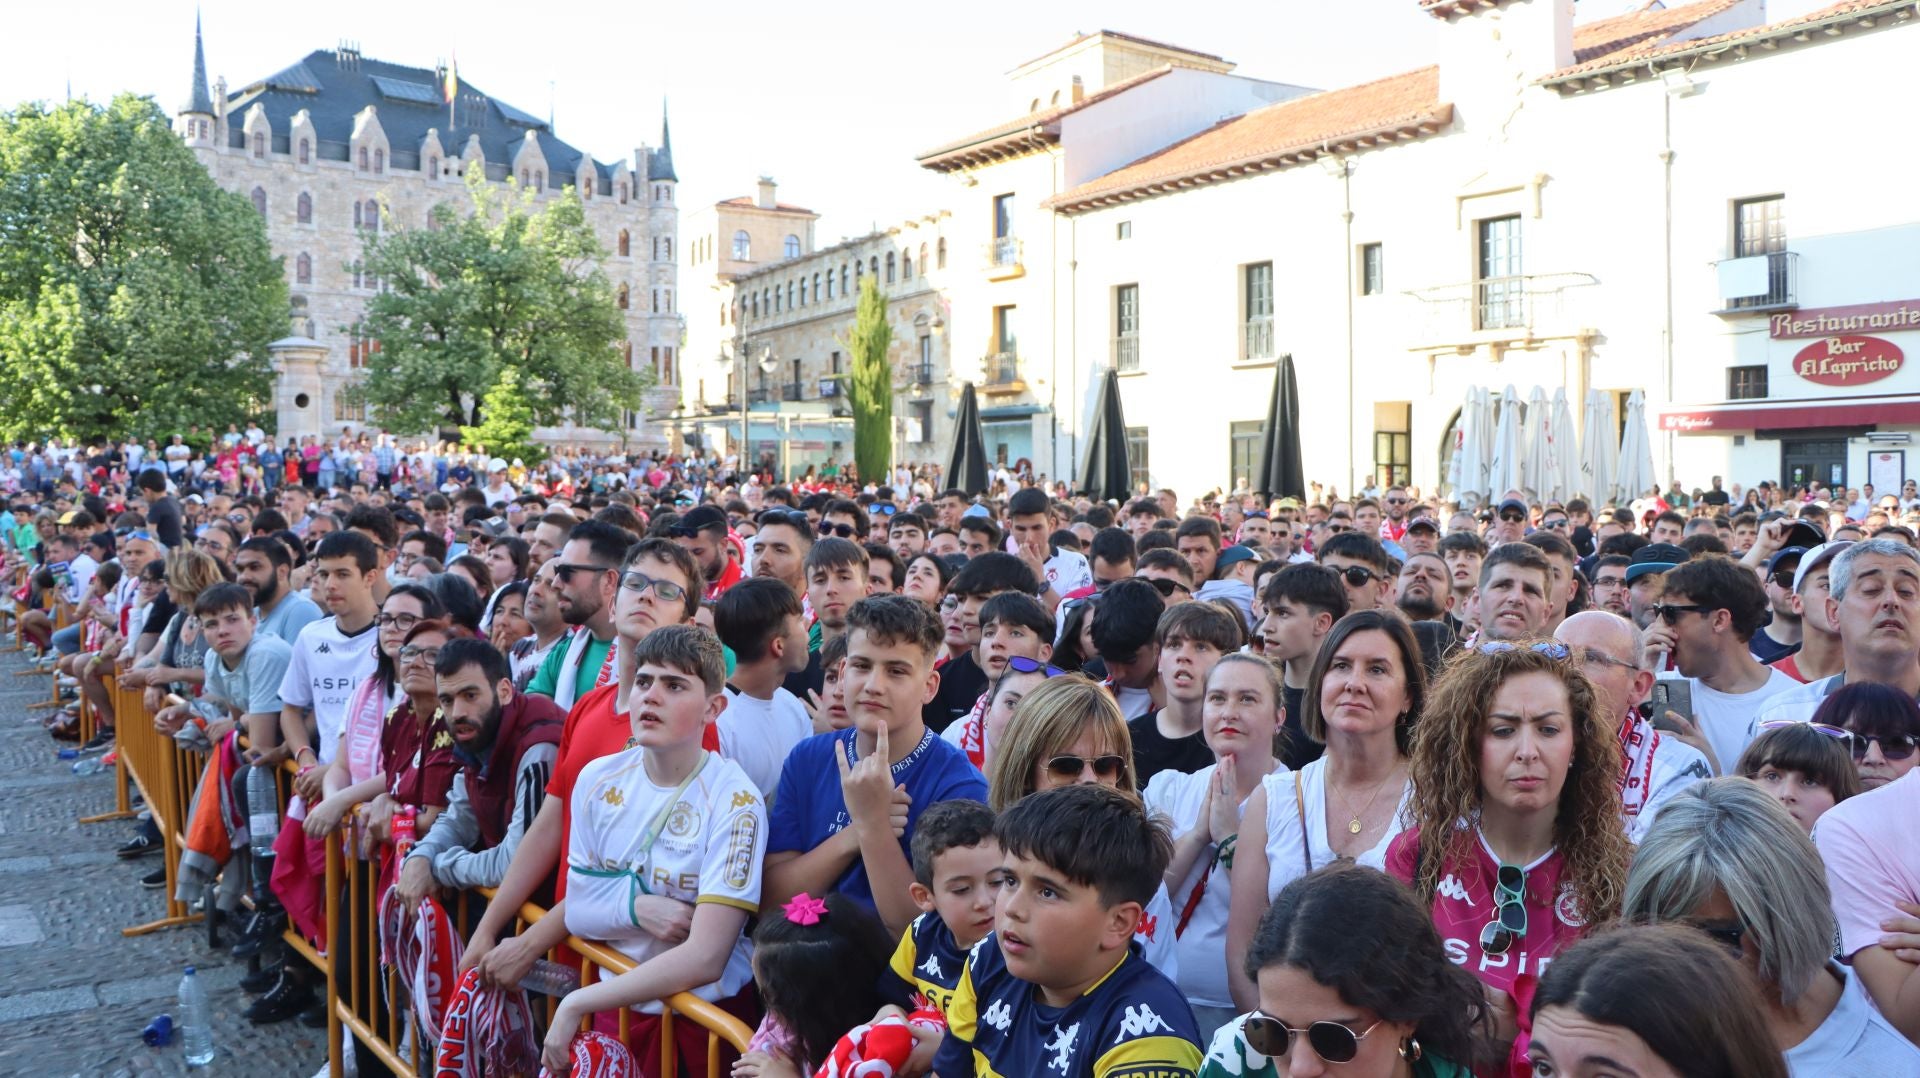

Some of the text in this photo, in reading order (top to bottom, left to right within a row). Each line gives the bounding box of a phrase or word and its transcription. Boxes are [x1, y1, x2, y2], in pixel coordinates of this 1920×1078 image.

[1771, 306, 1920, 336] Restaurante
[1825, 337, 1866, 354] Bar
[1800, 355, 1898, 380] El Capricho
